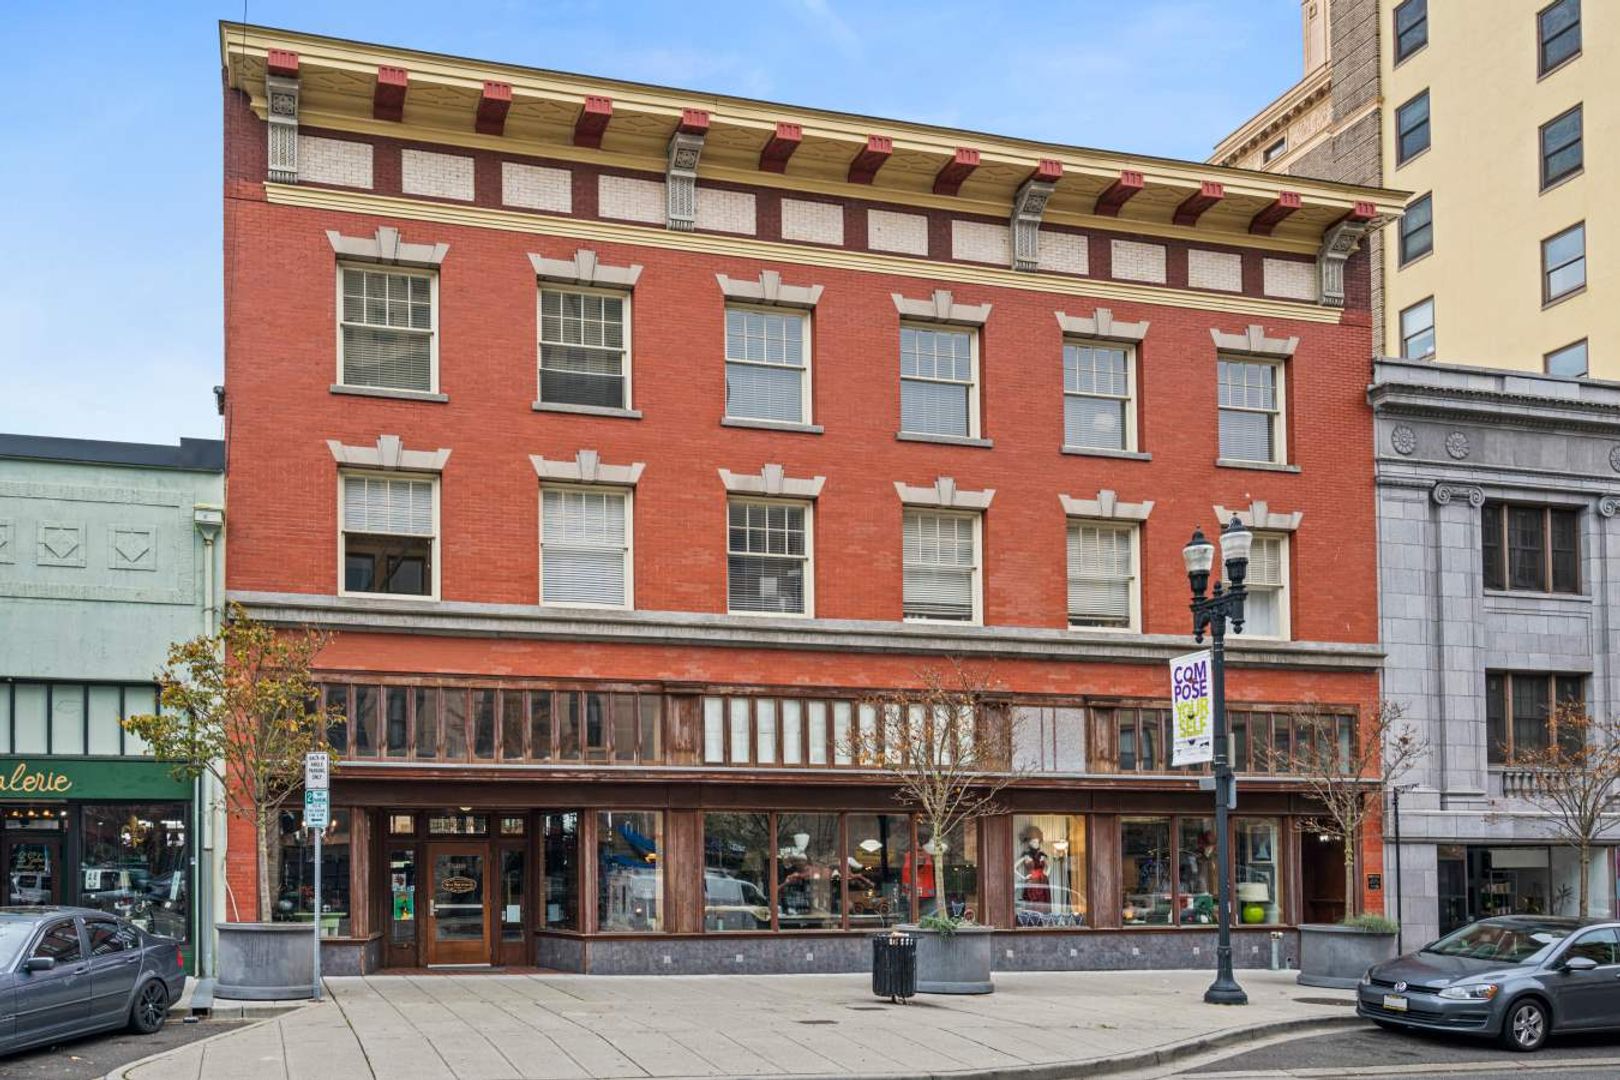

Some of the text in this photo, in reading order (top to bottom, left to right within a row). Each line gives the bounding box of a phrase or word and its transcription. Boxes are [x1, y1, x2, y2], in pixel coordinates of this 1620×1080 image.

[1174, 661, 1206, 684] COM
[1174, 680, 1208, 703] POSE
[1175, 697, 1209, 719] YOUR
[1179, 717, 1207, 738] SELF
